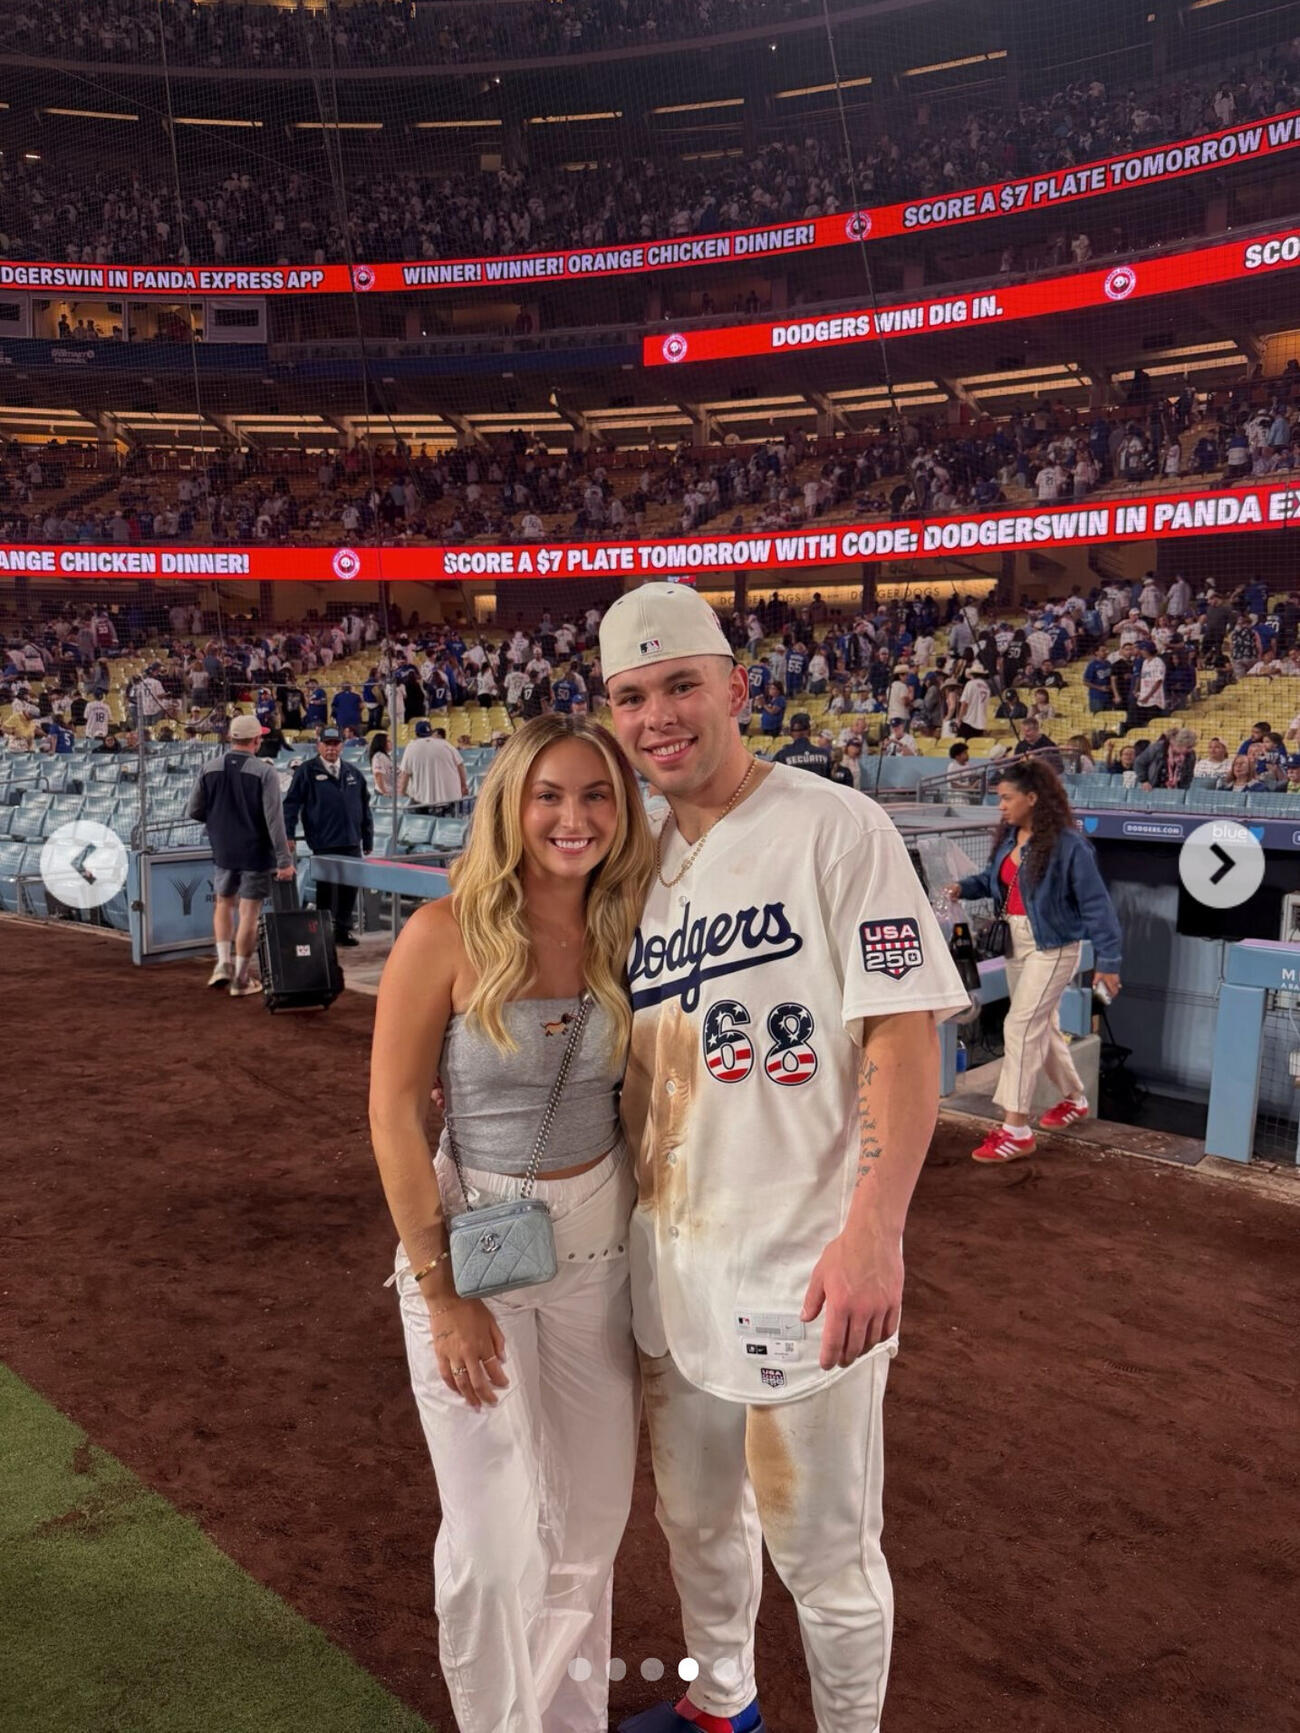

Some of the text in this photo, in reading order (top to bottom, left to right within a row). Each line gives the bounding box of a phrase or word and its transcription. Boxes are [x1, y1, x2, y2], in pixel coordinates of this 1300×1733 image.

[904, 195, 976, 227] SCORE
[980, 192, 997, 213] A
[1000, 184, 1029, 211] $7
[1034, 167, 1106, 202] PLATE
[1110, 127, 1263, 184] TOMORROW
[403, 263, 481, 285] WINNER!
[485, 257, 564, 280] WINNER!
[568, 249, 643, 273] ORANGE
[647, 238, 730, 265] CHICKEN
[735, 225, 815, 254] DINNER!
[1245, 236, 1300, 268] SCO
[0, 266, 325, 289] DGERSWIN IN PANDA EXPRESS APP
[772, 295, 1005, 347] DODGERS WIN! DIG IN.
[443, 551, 514, 574] SCORE
[517, 551, 534, 573] A
[536, 548, 564, 575] $7
[566, 547, 635, 571] PLATE
[638, 539, 773, 569] TOMORROW
[774, 534, 838, 561] WITH
[841, 527, 919, 557] CODE:
[922, 509, 1110, 551] DODGERSWIN
[1114, 505, 1148, 534] IN
[1153, 495, 1263, 531] PANDA
[60, 551, 156, 573] CHICKEN
[161, 553, 251, 574] DINNER!
[851, 587, 899, 601] DGER
[904, 586, 941, 598] DOGS
[785, 753, 828, 766] SECURITY
[1212, 824, 1248, 839] blue
[863, 925, 916, 942] USA
[865, 950, 923, 970] 250
[703, 1000, 818, 1086] 68
